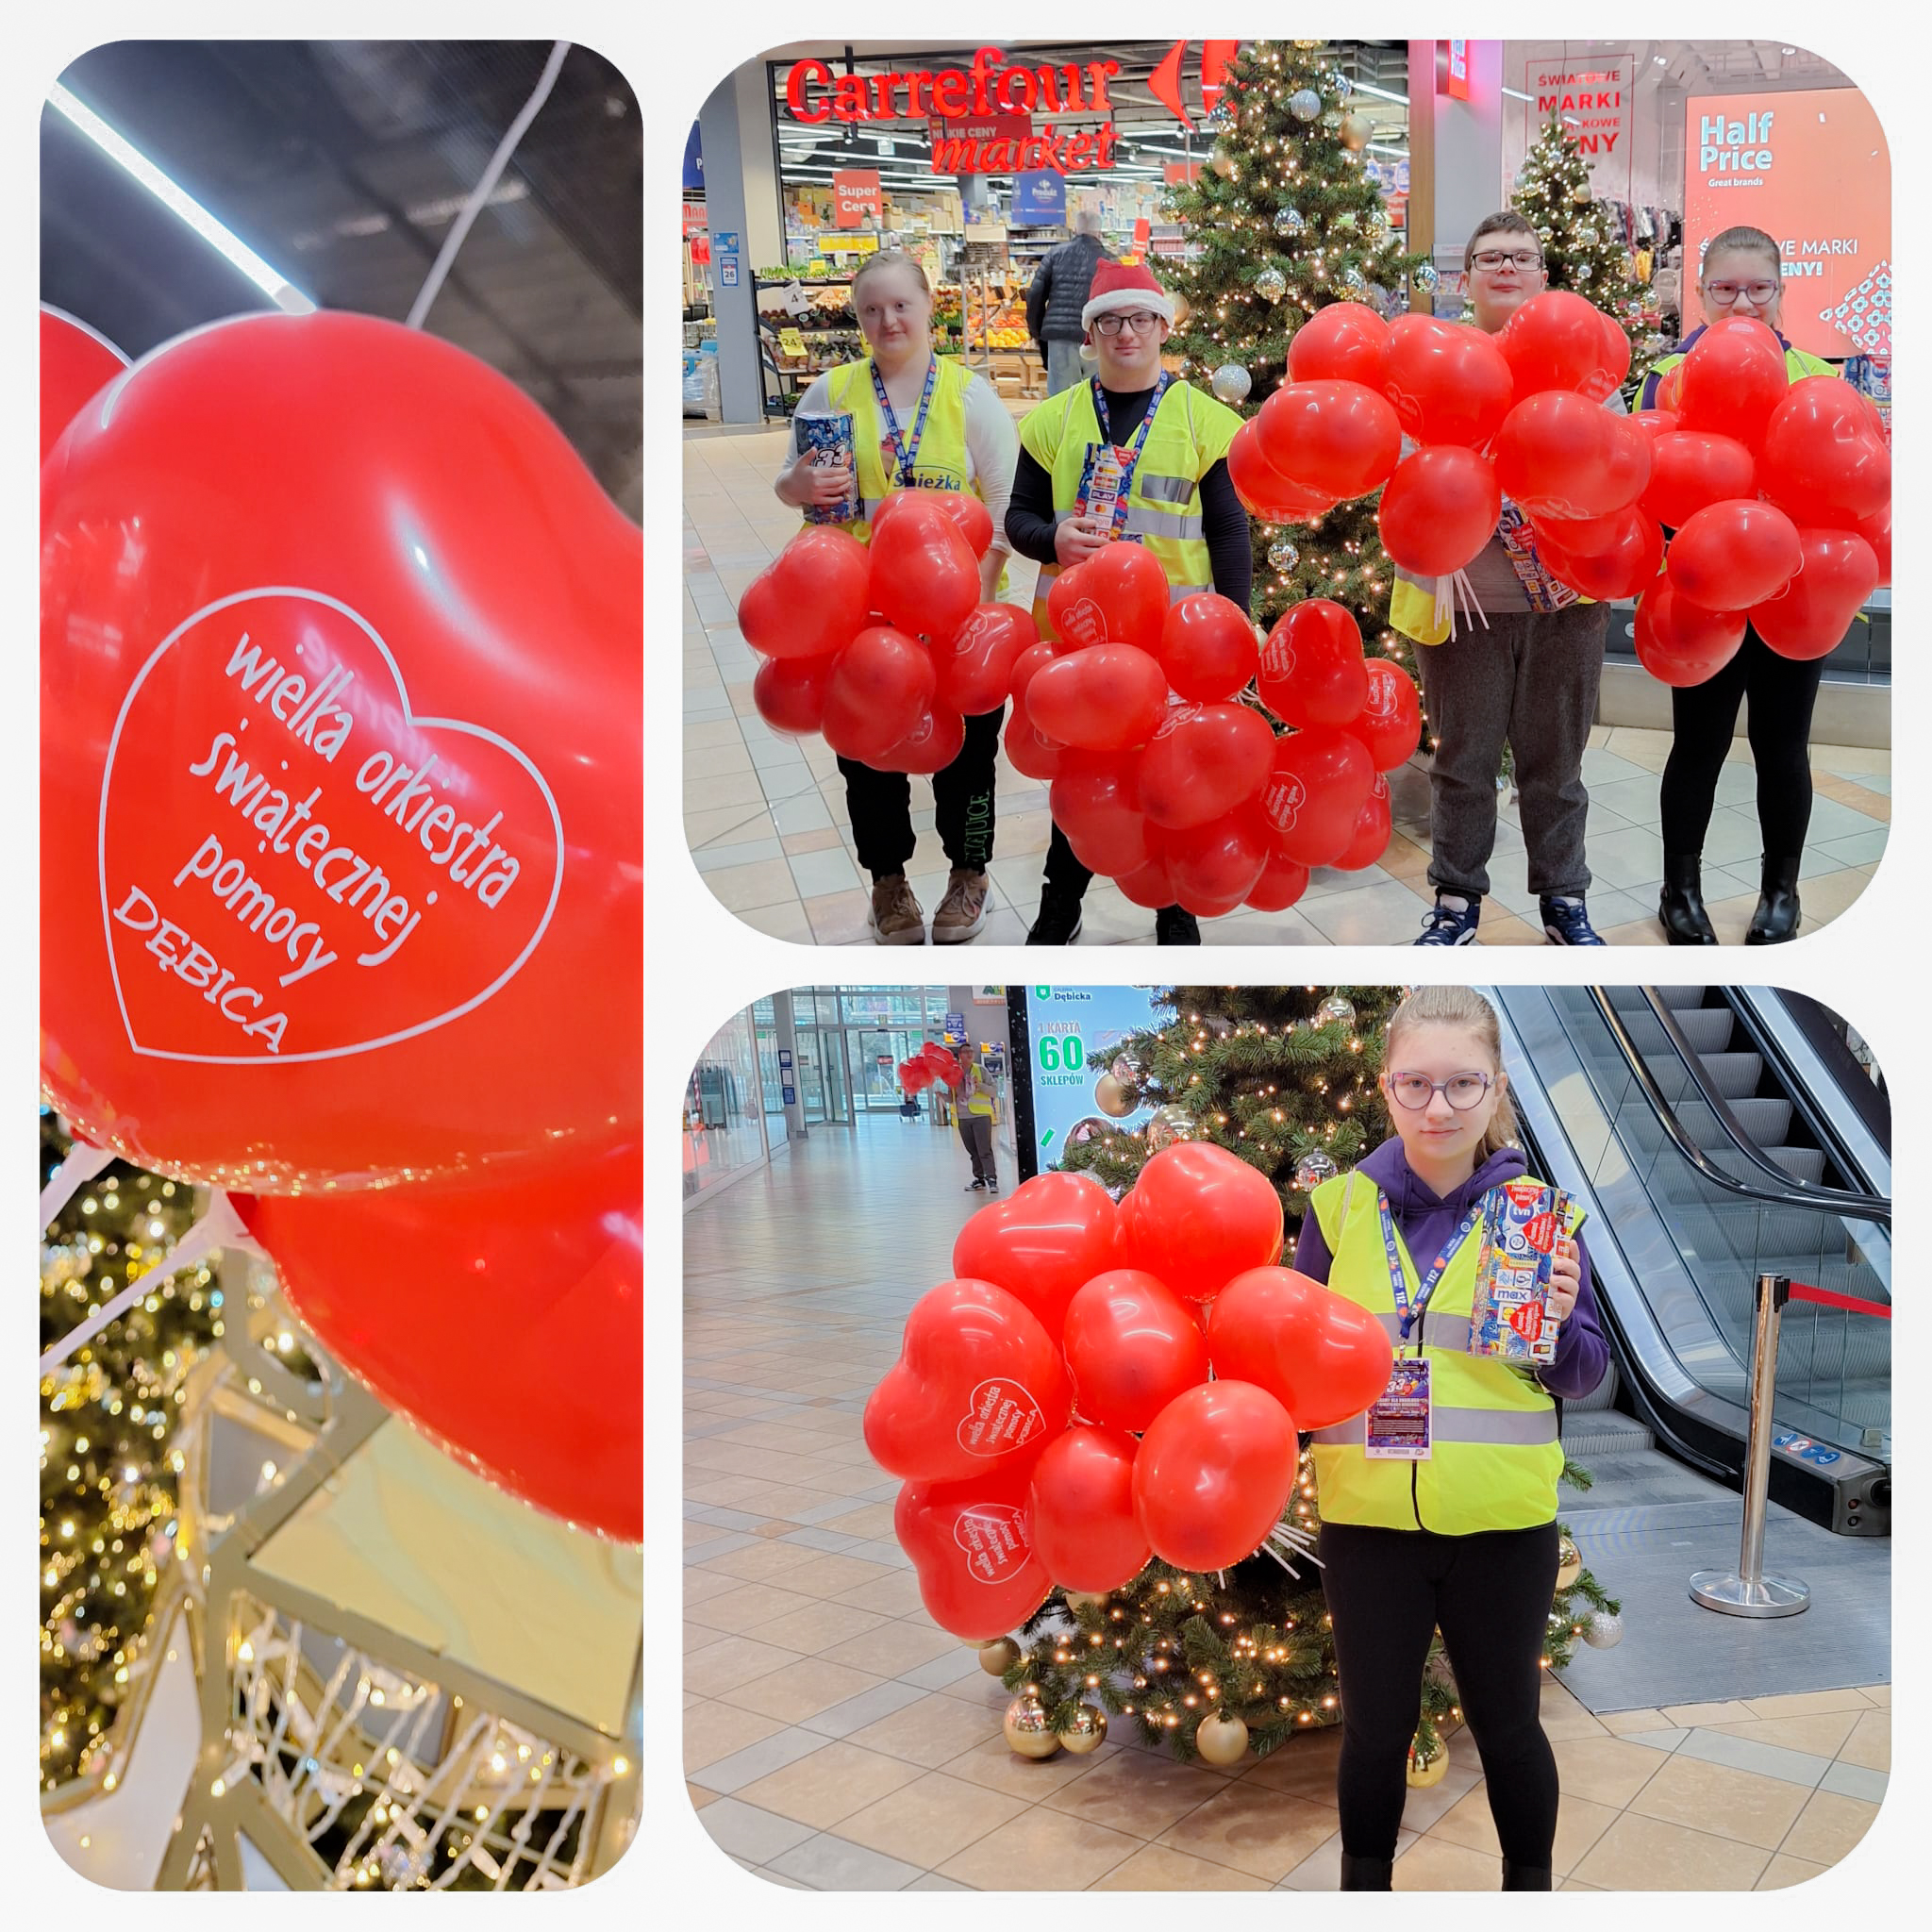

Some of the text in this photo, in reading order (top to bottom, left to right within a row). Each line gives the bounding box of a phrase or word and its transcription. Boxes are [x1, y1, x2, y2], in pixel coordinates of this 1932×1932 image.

[786, 46, 1122, 124] Carrefour
[1538, 70, 1621, 88] ŚWIATOWE
[1539, 92, 1621, 112] MARKI
[932, 126, 997, 139] NIKIE CENY
[1700, 111, 1774, 146] Half
[931, 121, 1123, 176] market
[1700, 144, 1774, 173] Price
[1707, 177, 1763, 188] Great brands
[838, 185, 877, 198] Super
[841, 199, 876, 212] Cena
[1801, 239, 1858, 256] MARKI
[1780, 260, 1824, 277] ENY!
[224, 631, 521, 910] wielka orkiestra
[189, 717, 439, 968] świątecznej
[173, 833, 339, 989] pomocy
[112, 884, 290, 1055] DĘBICA
[1054, 992, 1091, 1002] Dębicka
[1047, 1023, 1081, 1033] KARTA
[1039, 1035, 1084, 1071] 60
[1041, 1073, 1084, 1086] SKLEPÓW
[1426, 1269, 1440, 1283] 112
[1395, 1291, 1407, 1305] 112
[1498, 1290, 1528, 1300] max
[1386, 1378, 1406, 1393] 33
[1003, 1408, 1025, 1440] pomocy
